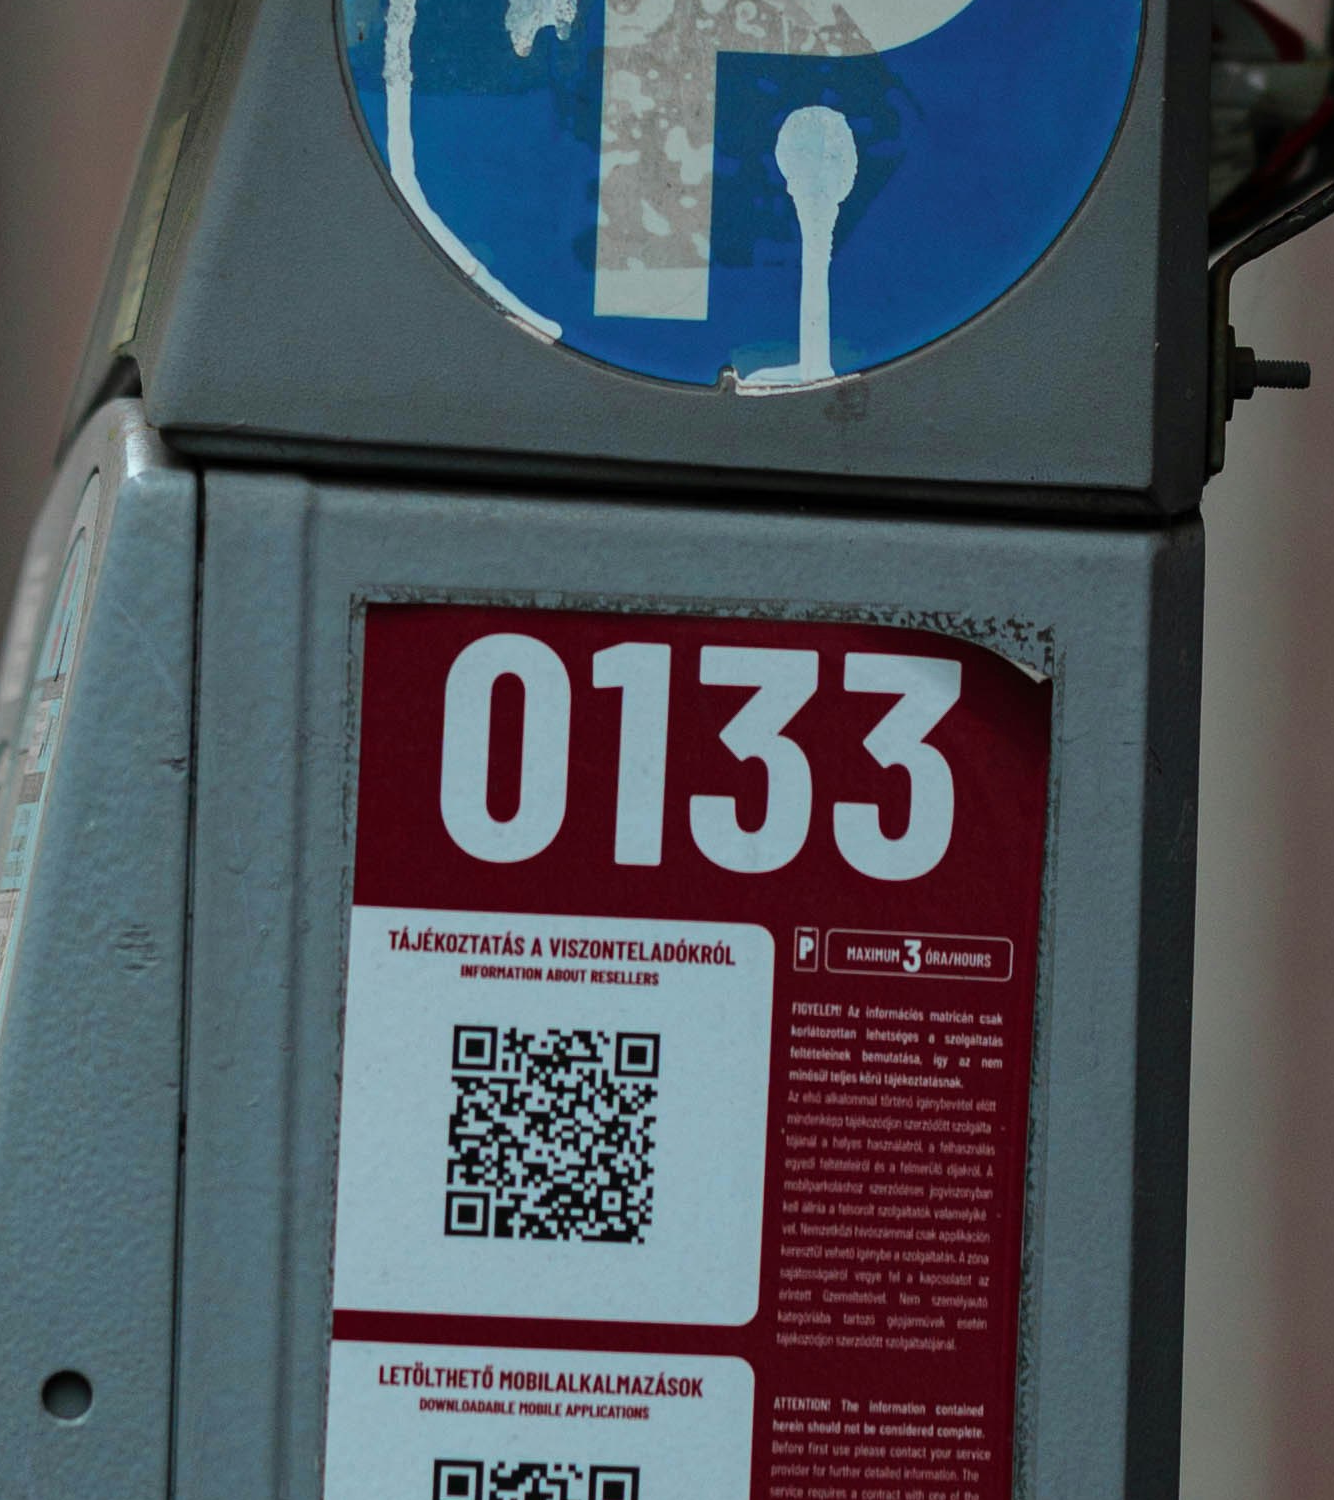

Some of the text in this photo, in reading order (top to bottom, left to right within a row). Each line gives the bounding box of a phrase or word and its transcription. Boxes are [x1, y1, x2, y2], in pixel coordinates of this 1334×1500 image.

[440, 633, 961, 881] 0133
[388, 927, 735, 965] TÁJÉKOZTATÁS A VISZONTELADÓKRÓL
[847, 939, 991, 972] MAXIMUM 3 ÓRA/HOURS
[460, 964, 659, 986] INFORMATION ABOUT RESELLERS
[792, 1002, 842, 1016] FIGYELEM!
[847, 1005, 860, 1018] Az
[979, 1013, 1002, 1025] csak
[379, 1362, 702, 1397] LETÖLTHETŐ MOBILALKALMAZÁSOK
[419, 1397, 649, 1420] DOWNLOADABLE MOBILE APPLICATIONS
[773, 1396, 984, 1416] ATTENTION! The information contained
[772, 1419, 988, 1440] herein should not be considered complete.
